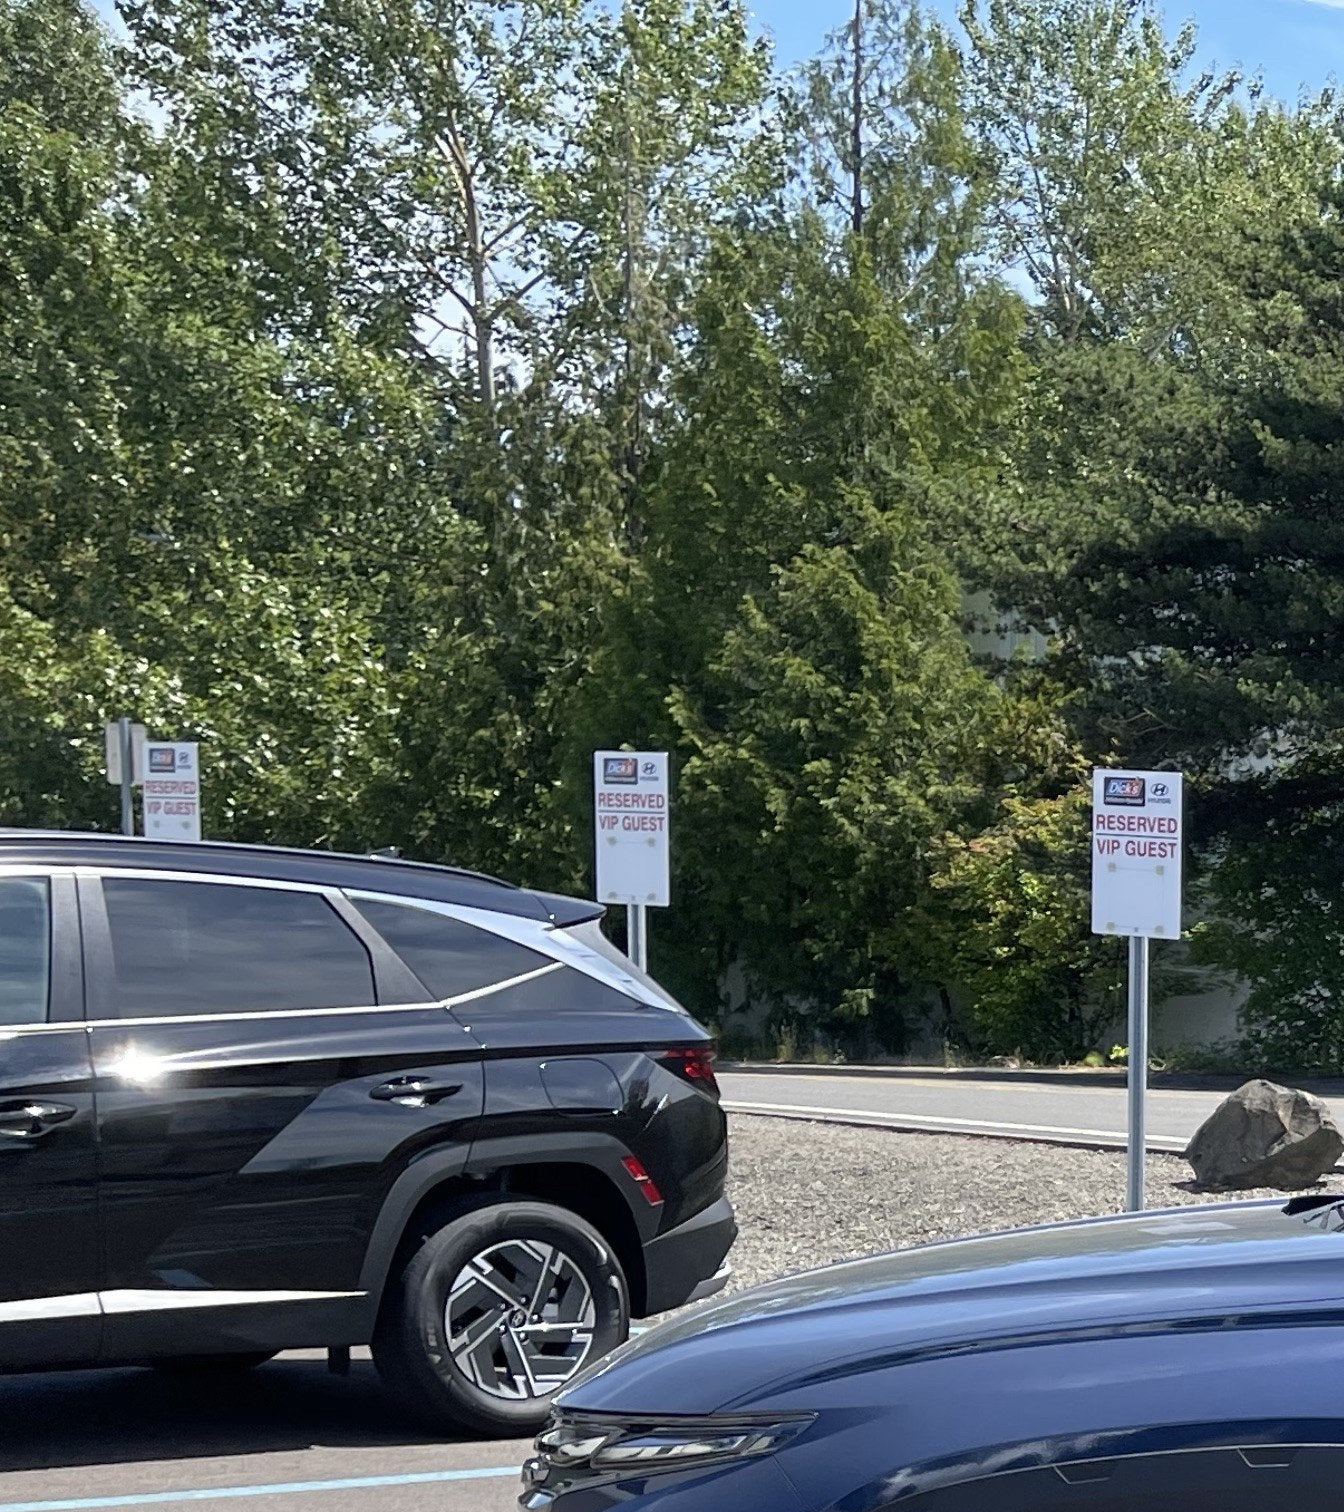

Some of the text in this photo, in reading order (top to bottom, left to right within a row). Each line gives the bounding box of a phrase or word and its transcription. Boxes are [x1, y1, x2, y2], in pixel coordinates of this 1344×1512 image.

[145, 780, 197, 795] RESERVED
[147, 801, 197, 816] VIP GUEST
[598, 792, 665, 809] RESERVED
[598, 815, 665, 832] VIP GUEST
[1096, 814, 1178, 834] RESERVED
[1096, 838, 1178, 859] VIP GUEST
